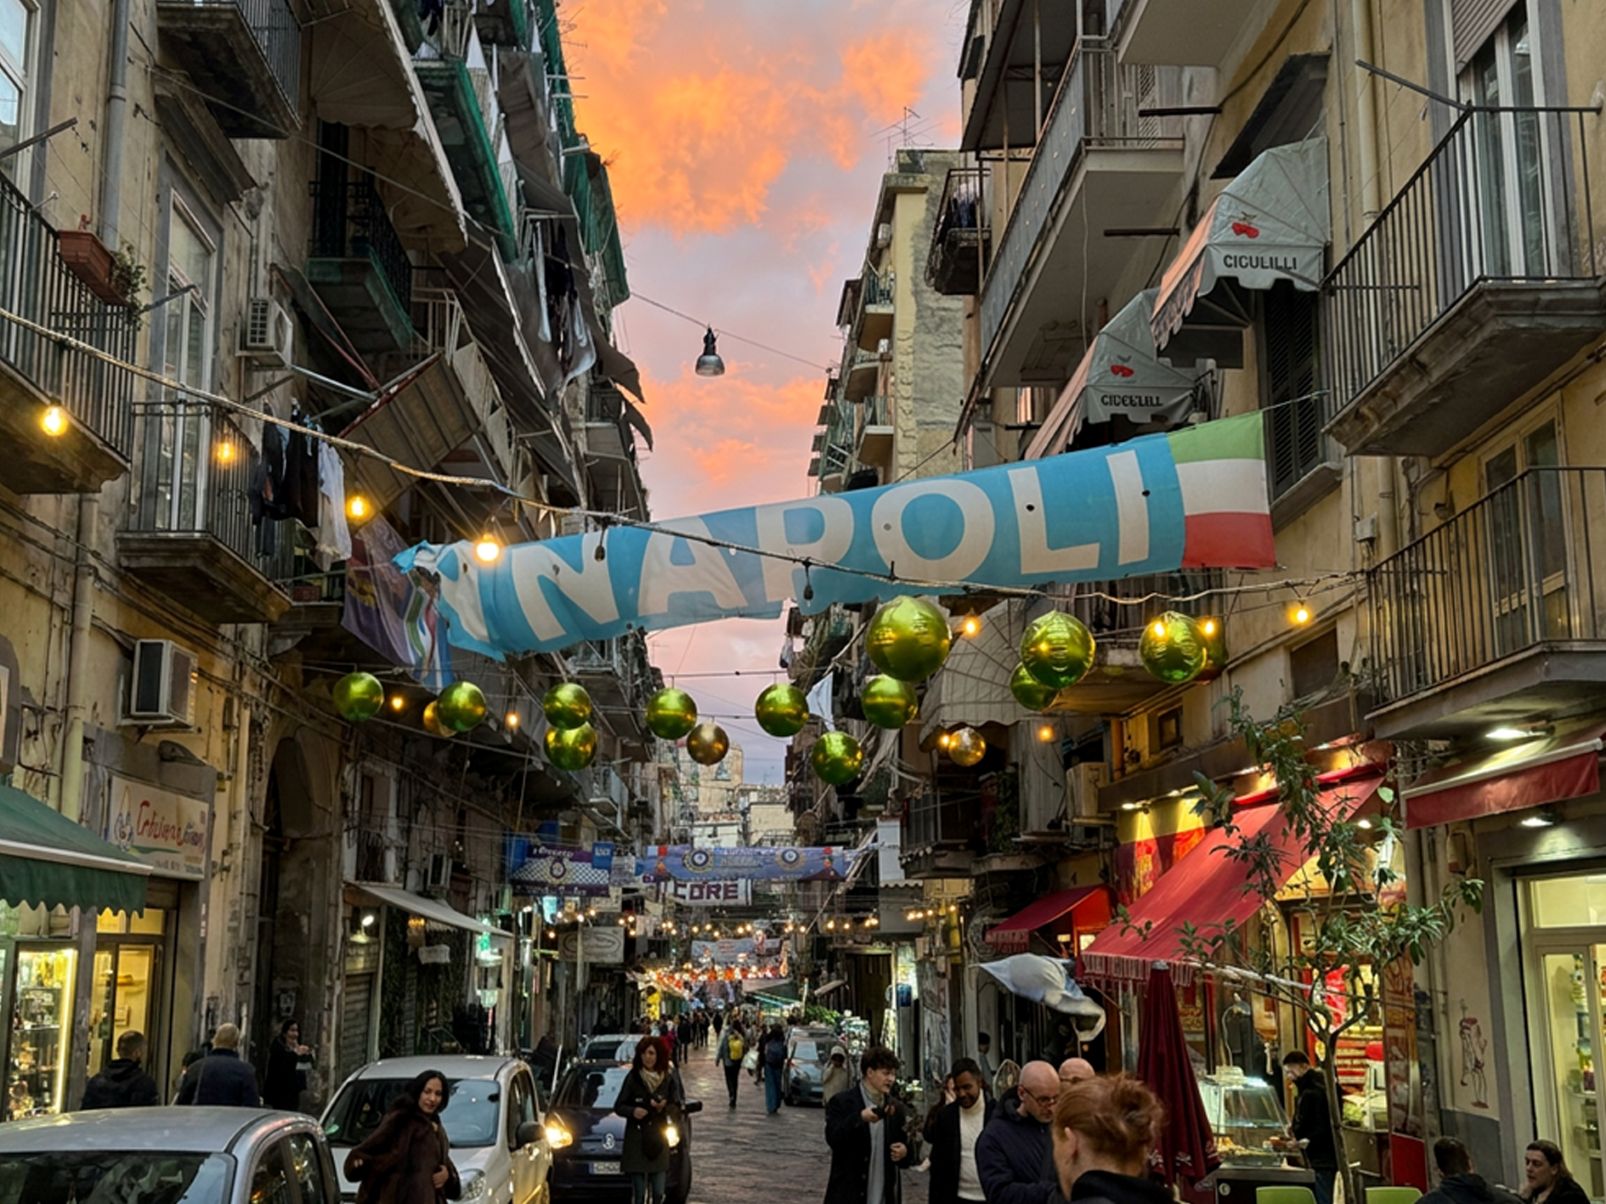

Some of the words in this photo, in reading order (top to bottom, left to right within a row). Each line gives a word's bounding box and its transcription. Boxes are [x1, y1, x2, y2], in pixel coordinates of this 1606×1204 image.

[1223, 254, 1297, 270] CICULILLI
[512, 450, 1150, 642] NAPOLI
[674, 880, 739, 900] CORE
